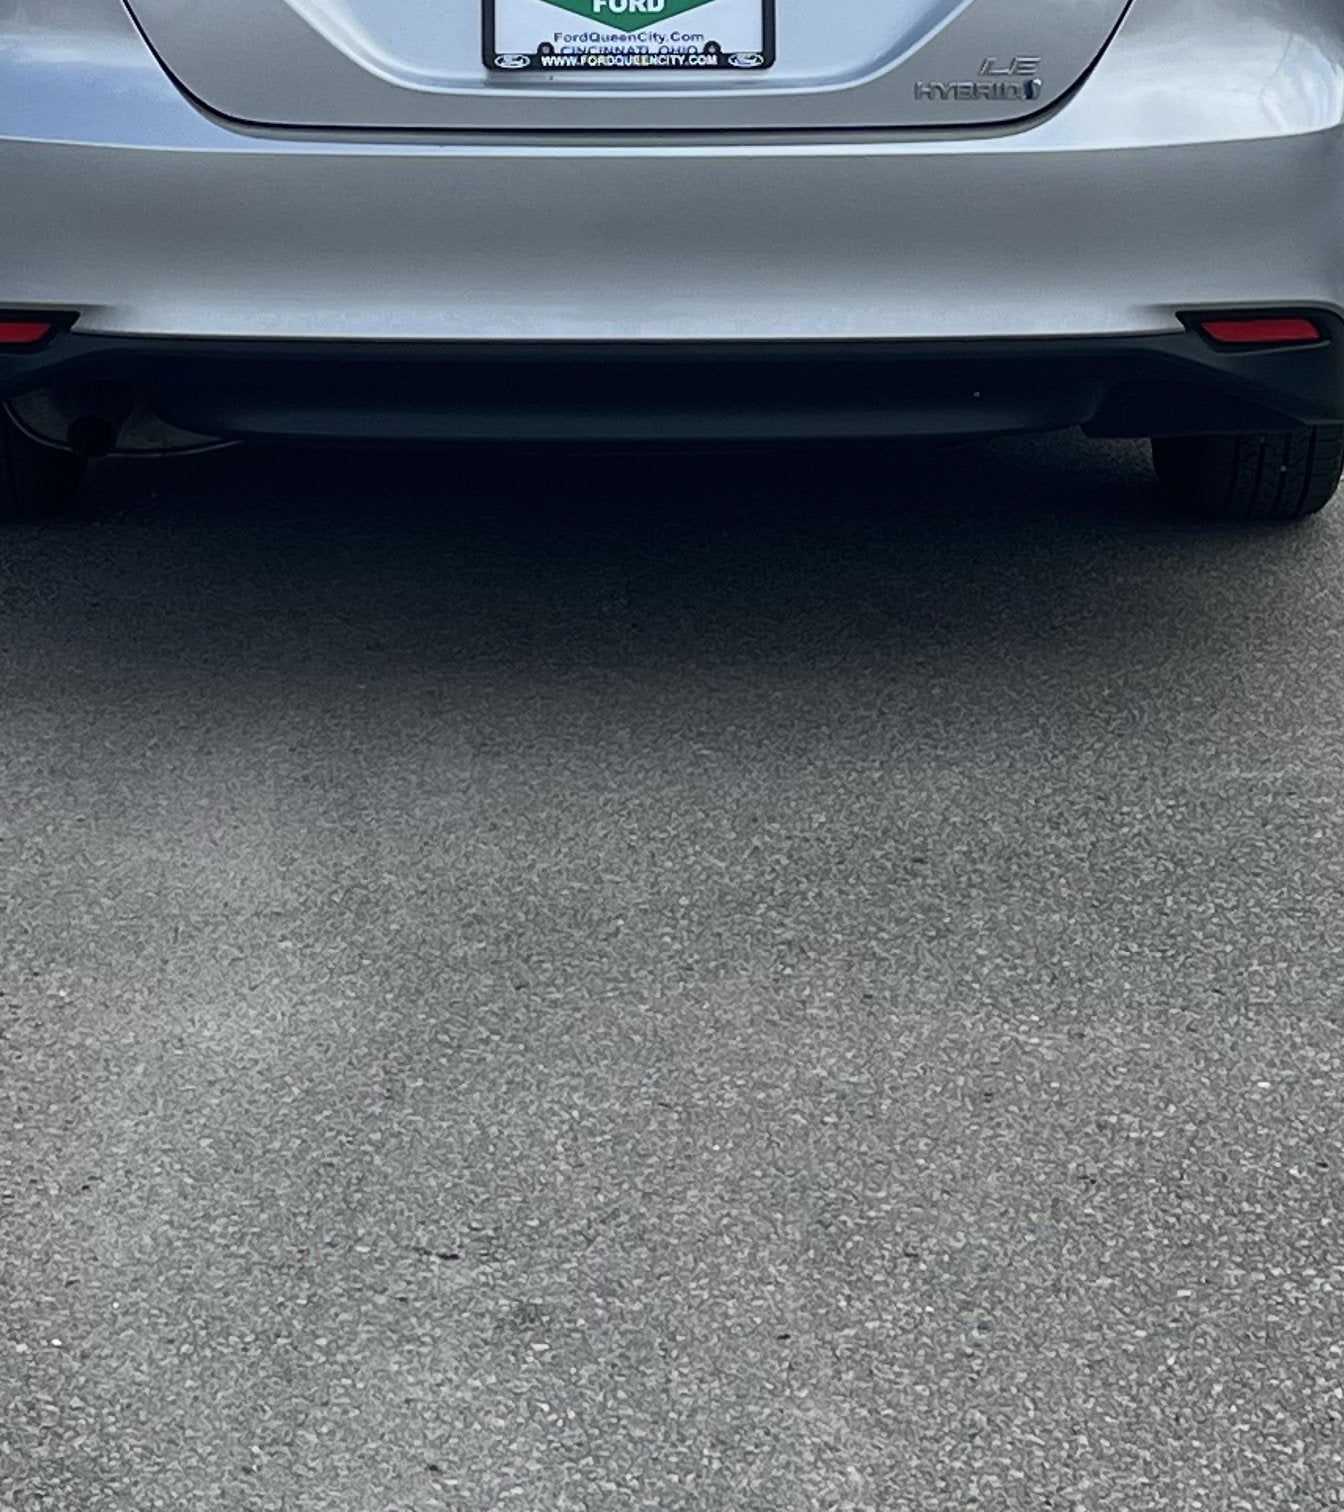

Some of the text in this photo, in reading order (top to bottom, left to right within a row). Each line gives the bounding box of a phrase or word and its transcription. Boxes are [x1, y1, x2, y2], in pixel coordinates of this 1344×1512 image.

[553, 31, 705, 45] FordQueenCity.Com
[541, 54, 718, 67] WWW.FORDQUEENCITY.COM
[979, 56, 1042, 76] LE
[914, 80, 1022, 101] HYBRID
